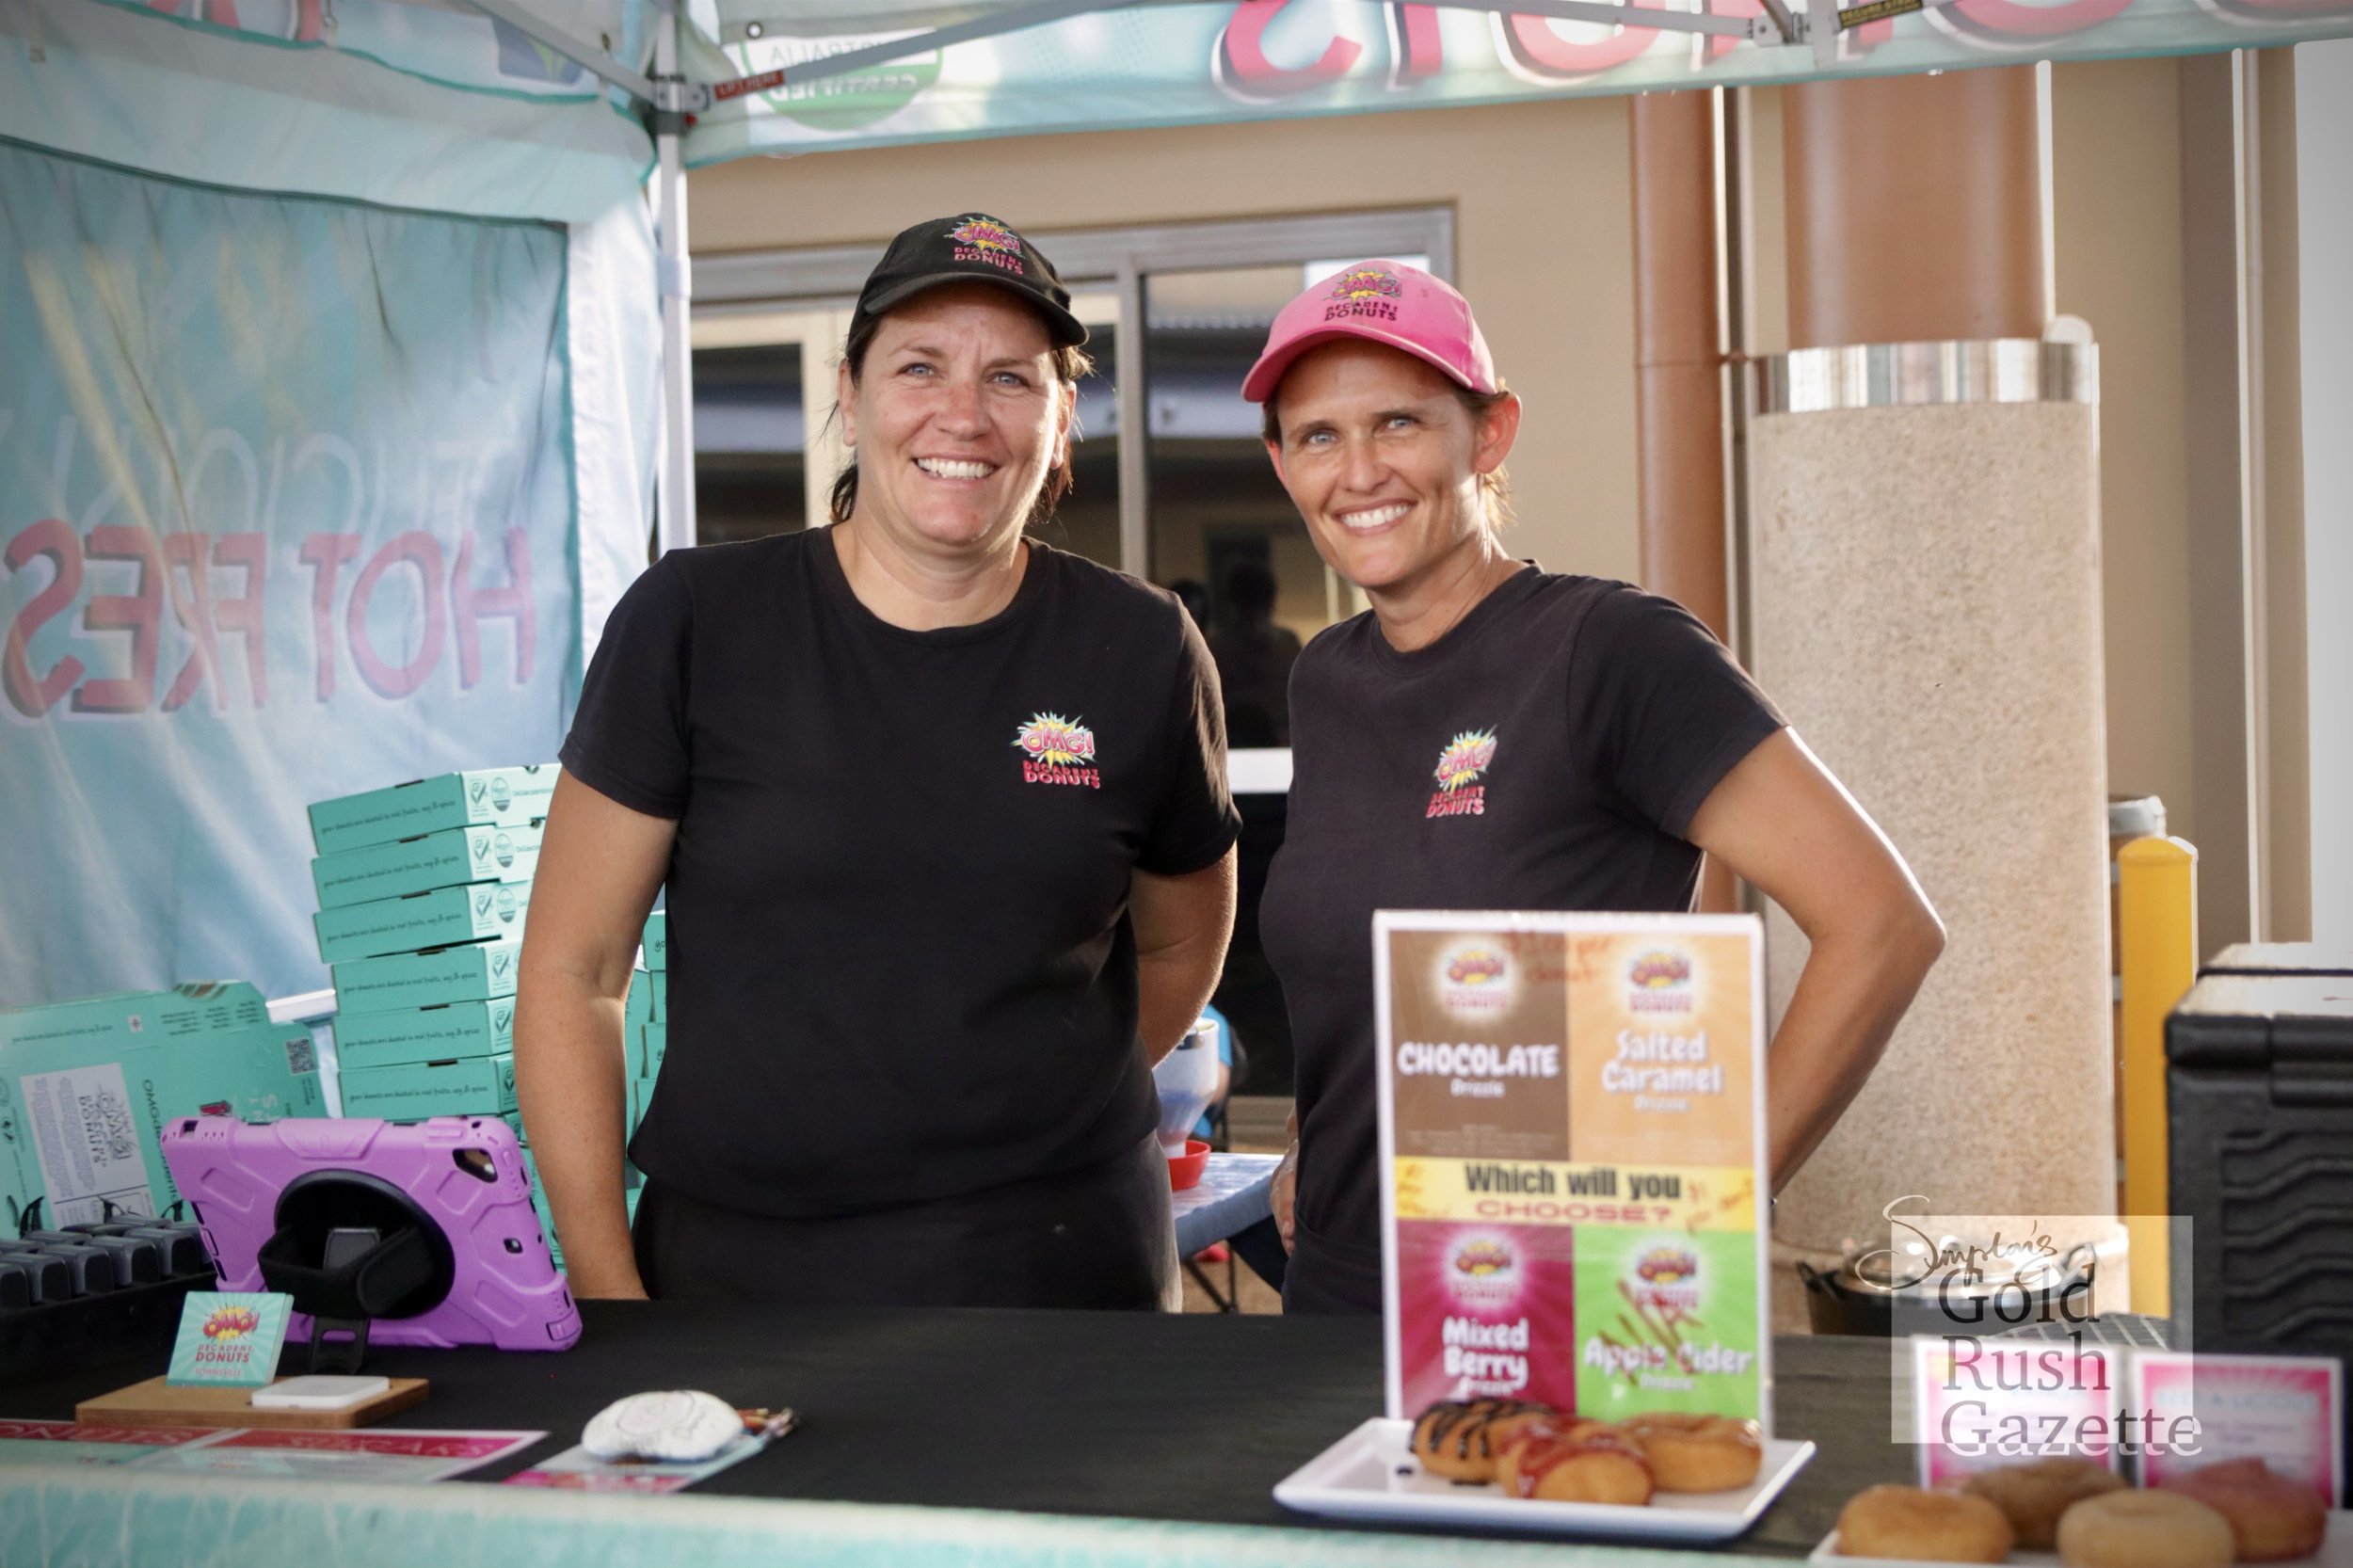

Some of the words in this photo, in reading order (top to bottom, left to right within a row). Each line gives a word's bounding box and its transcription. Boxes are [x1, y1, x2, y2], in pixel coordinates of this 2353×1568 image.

[954, 253, 1023, 275] DONUTS
[1324, 308, 1397, 321] DONUTS
[1020, 727, 1096, 756] OMG!
[1023, 770, 1100, 789] DONUTS
[1398, 1041, 1561, 1079] CHOCOLATE
[1616, 1029, 1710, 1063] Salted
[1602, 1060, 1724, 1095] Caramel
[1465, 1162, 1556, 1196] Which
[1565, 1167, 1617, 1198] will
[1627, 1173, 1682, 1202] you
[1476, 1199, 1672, 1223] CHOOSE?
[1442, 1317, 1529, 1352] Mixed
[196, 1351, 250, 1363] DONUTS
[1444, 1346, 1529, 1390] Berry
[1582, 1336, 1667, 1377] Apple
[1675, 1340, 1753, 1375] Cider
